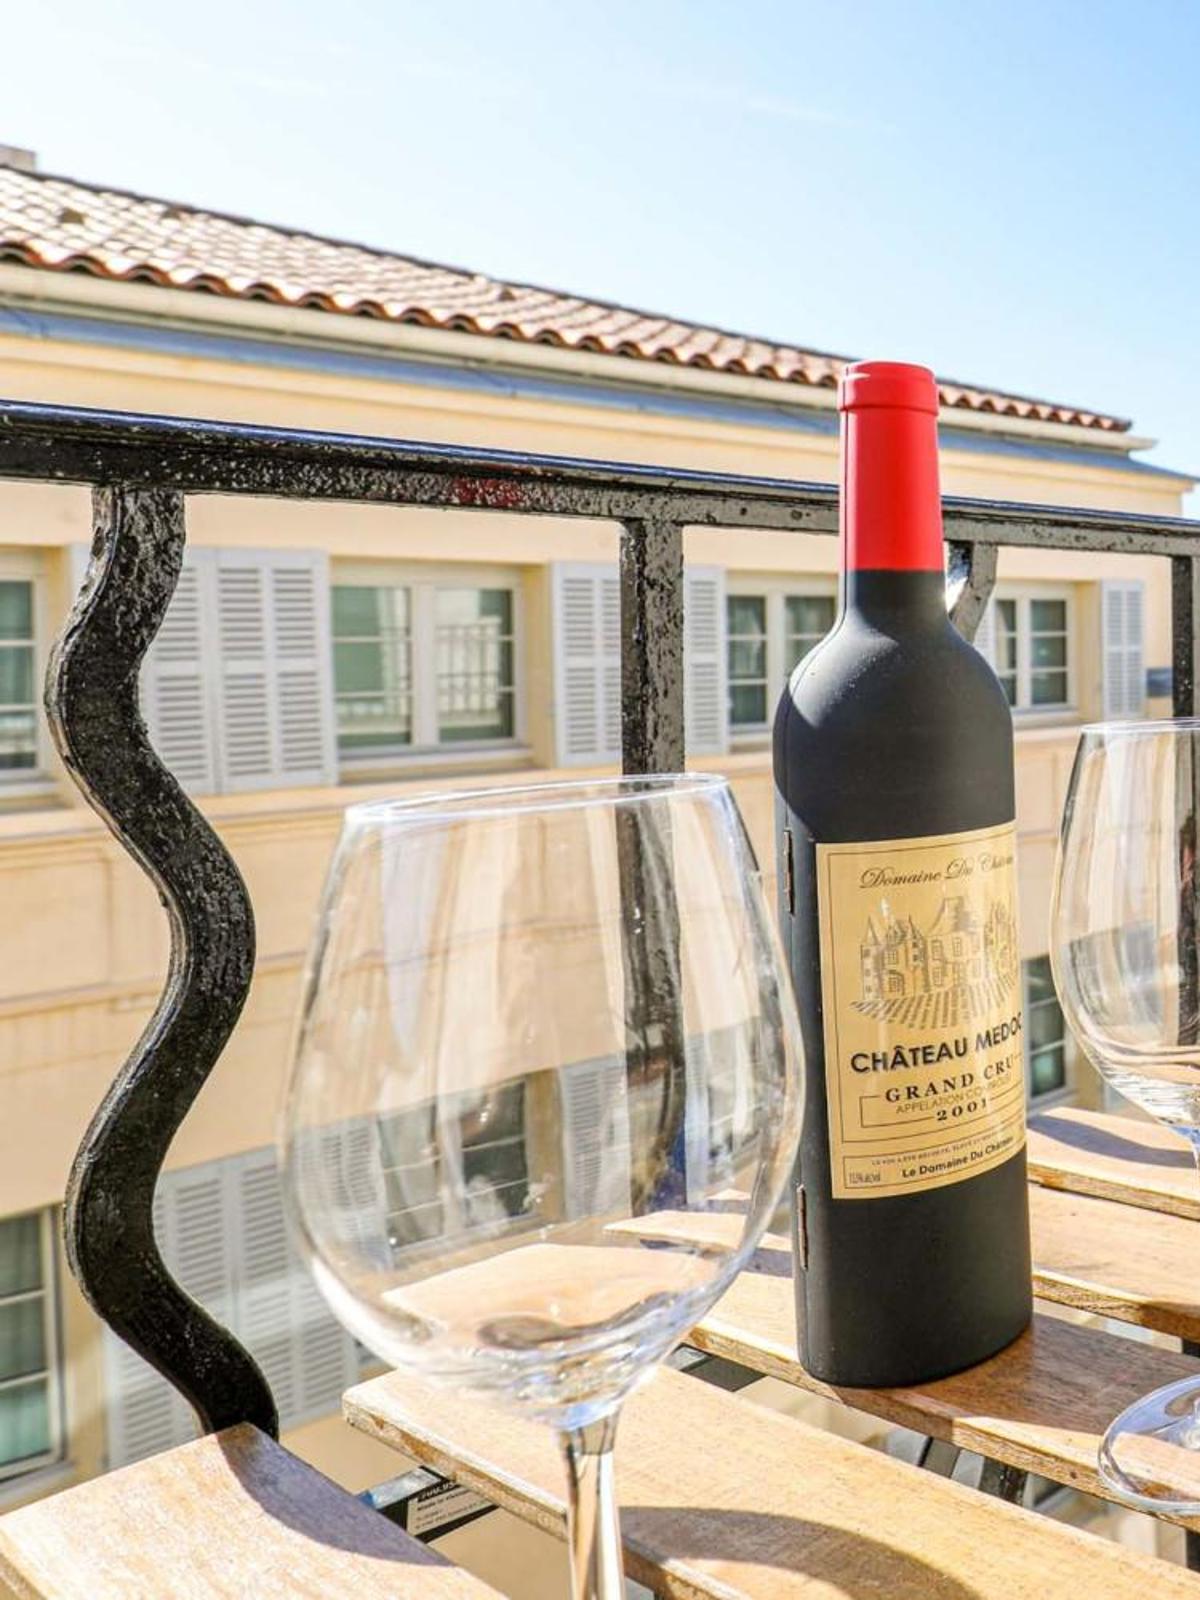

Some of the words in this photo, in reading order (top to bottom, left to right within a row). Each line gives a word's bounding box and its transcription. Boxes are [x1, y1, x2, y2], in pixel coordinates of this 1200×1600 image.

[859, 866, 942, 889] Domaine
[850, 1037, 969, 1074] CHÂTEAU
[975, 1011, 1022, 1052] MEDOC
[885, 1072, 974, 1103] GRAND
[983, 1053, 1014, 1081] CRU
[936, 1098, 988, 1122] 2001
[901, 1167, 916, 1179] Le
[919, 1156, 969, 1176] Domaine
[970, 1150, 983, 1162] Du
